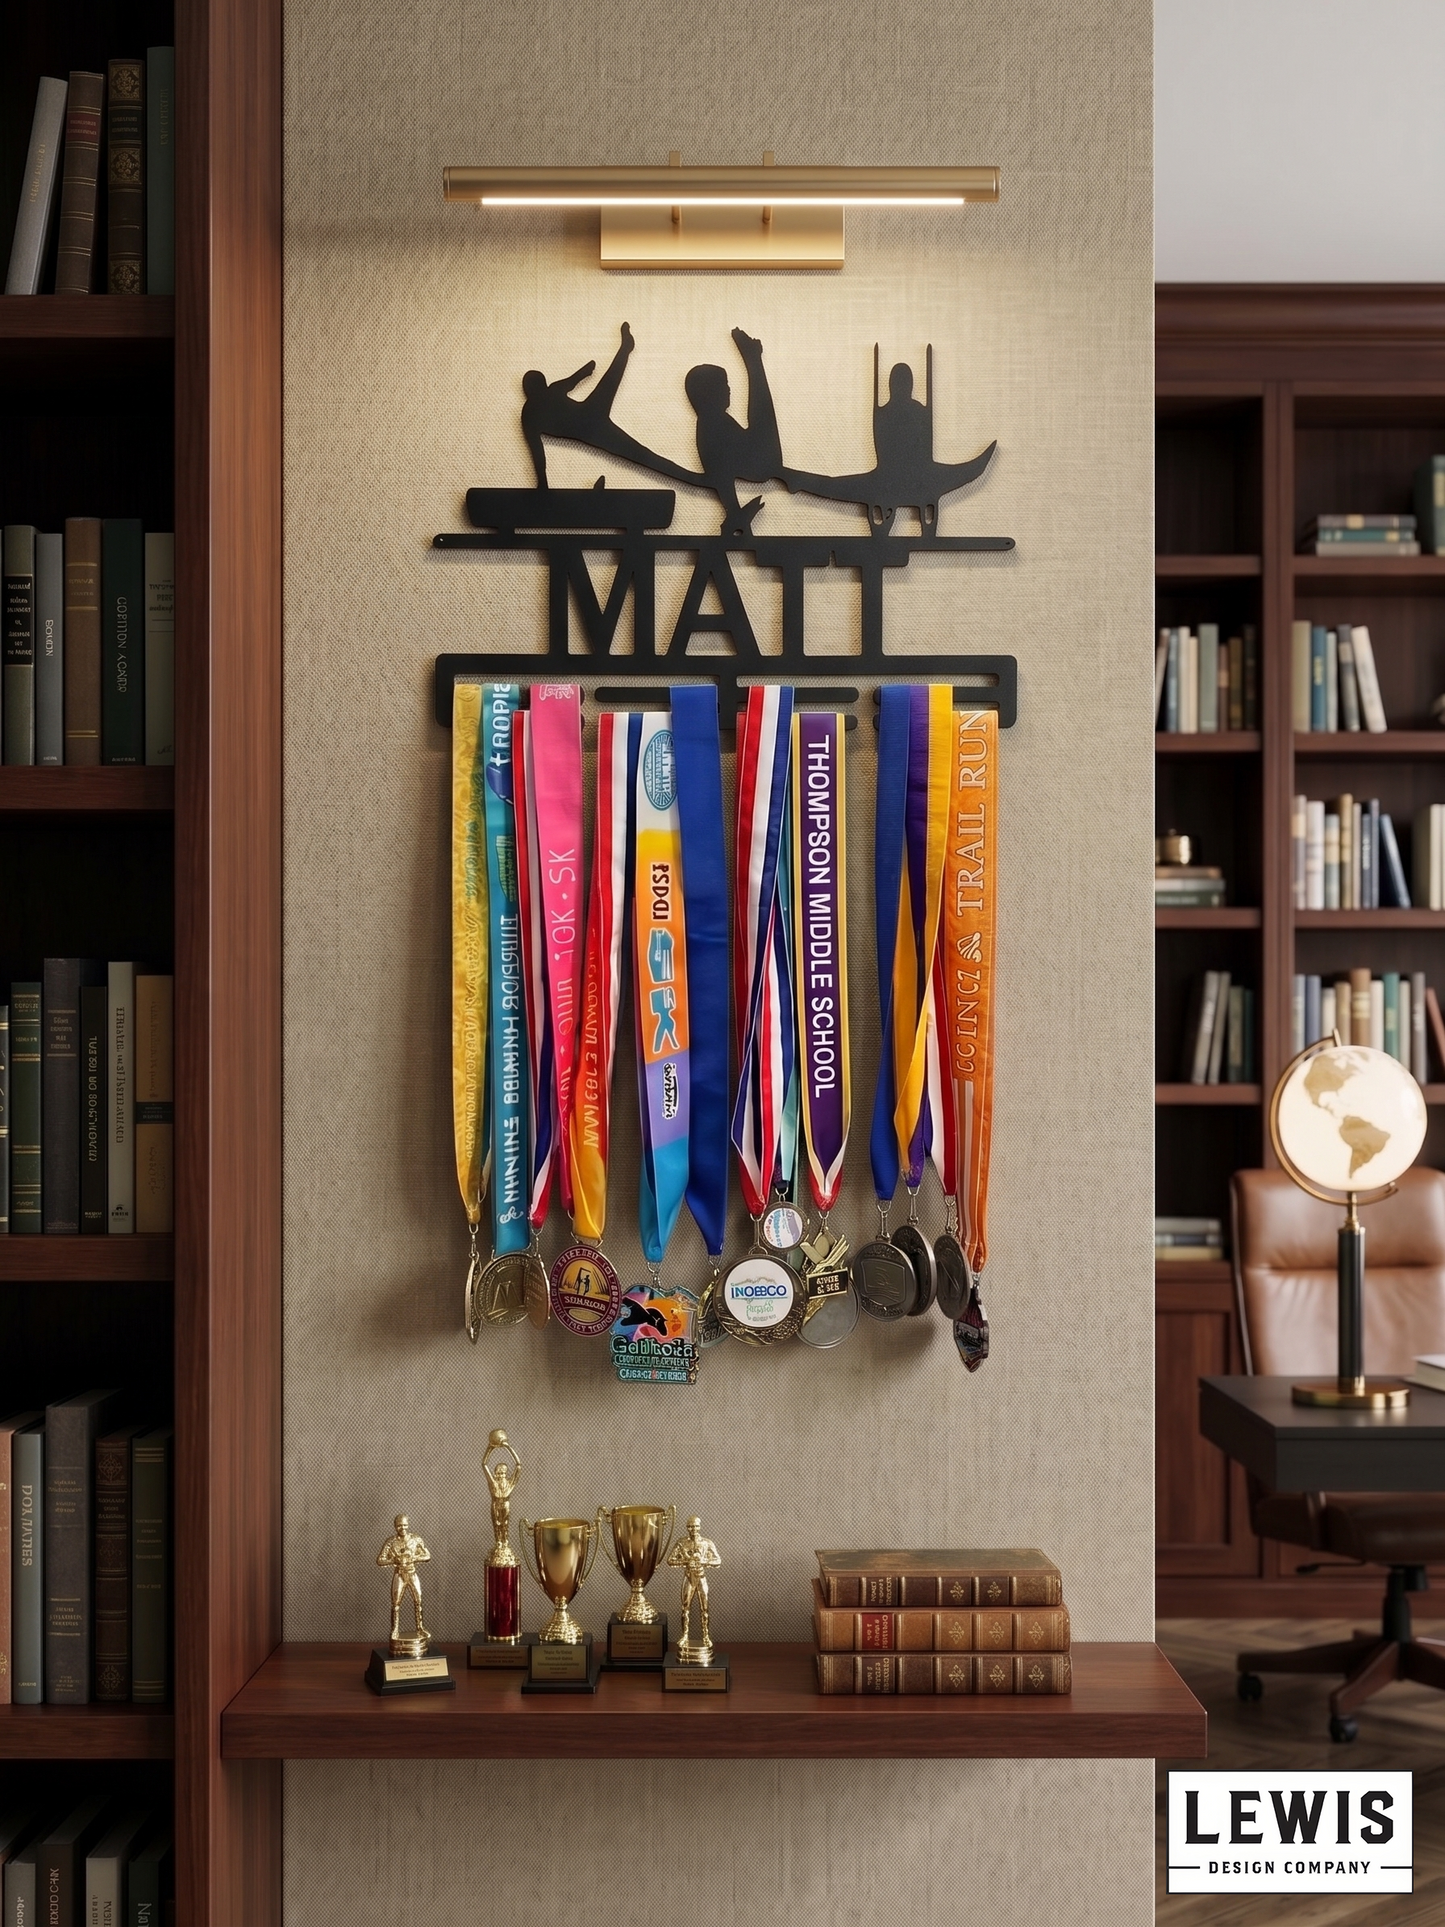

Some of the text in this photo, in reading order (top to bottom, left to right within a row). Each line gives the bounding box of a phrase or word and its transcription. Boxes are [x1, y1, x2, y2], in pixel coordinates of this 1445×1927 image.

[548, 548, 909, 657] MATT
[959, 710, 989, 791] RUN
[957, 803, 986, 917] TRAIL
[807, 734, 836, 1098] THOMPSON MIDDLE SCHOOL
